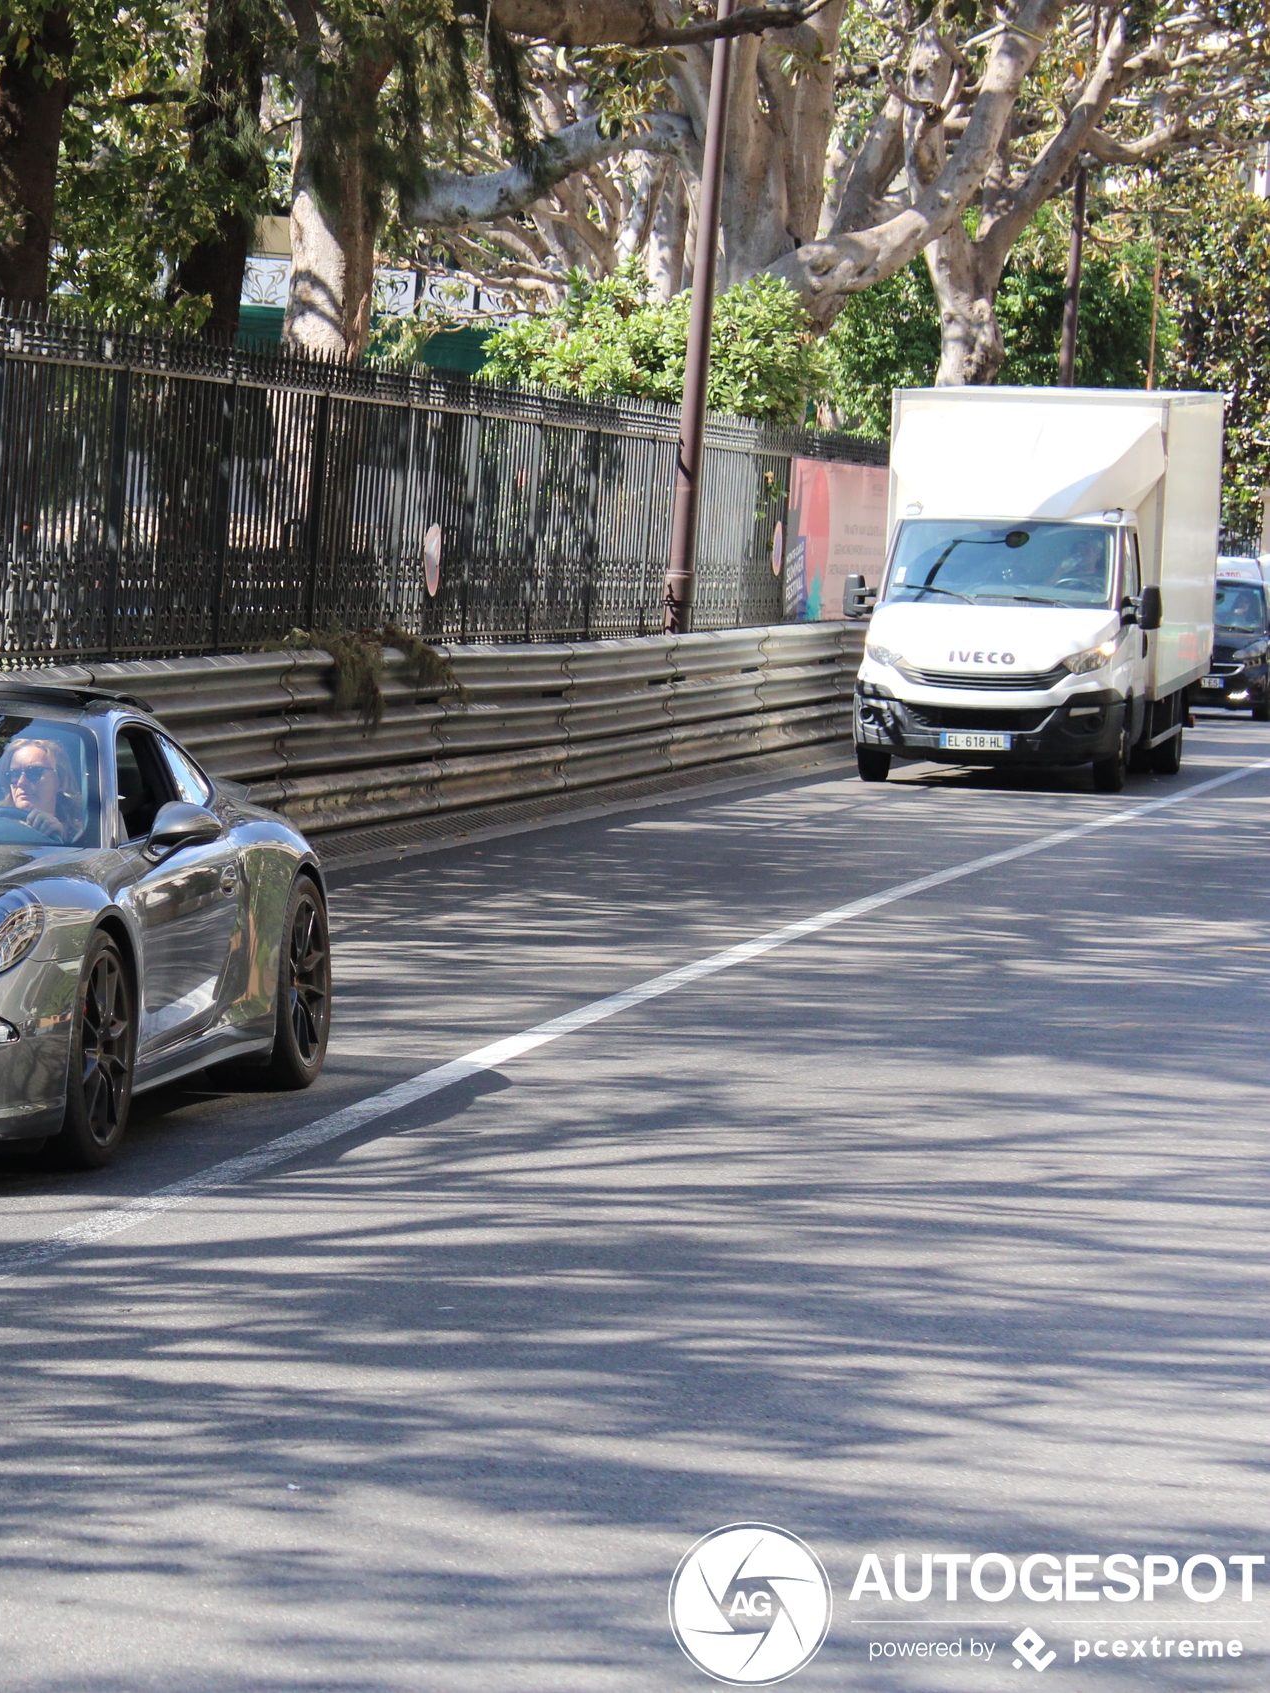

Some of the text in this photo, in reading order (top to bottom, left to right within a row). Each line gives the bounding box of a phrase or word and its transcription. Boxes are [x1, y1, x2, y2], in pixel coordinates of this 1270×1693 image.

[786, 554, 804, 584] SUMMER
[785, 574, 804, 602] FESTIVAL
[948, 650, 1016, 665] IVECO
[947, 735, 1003, 748] EL-618-HL
